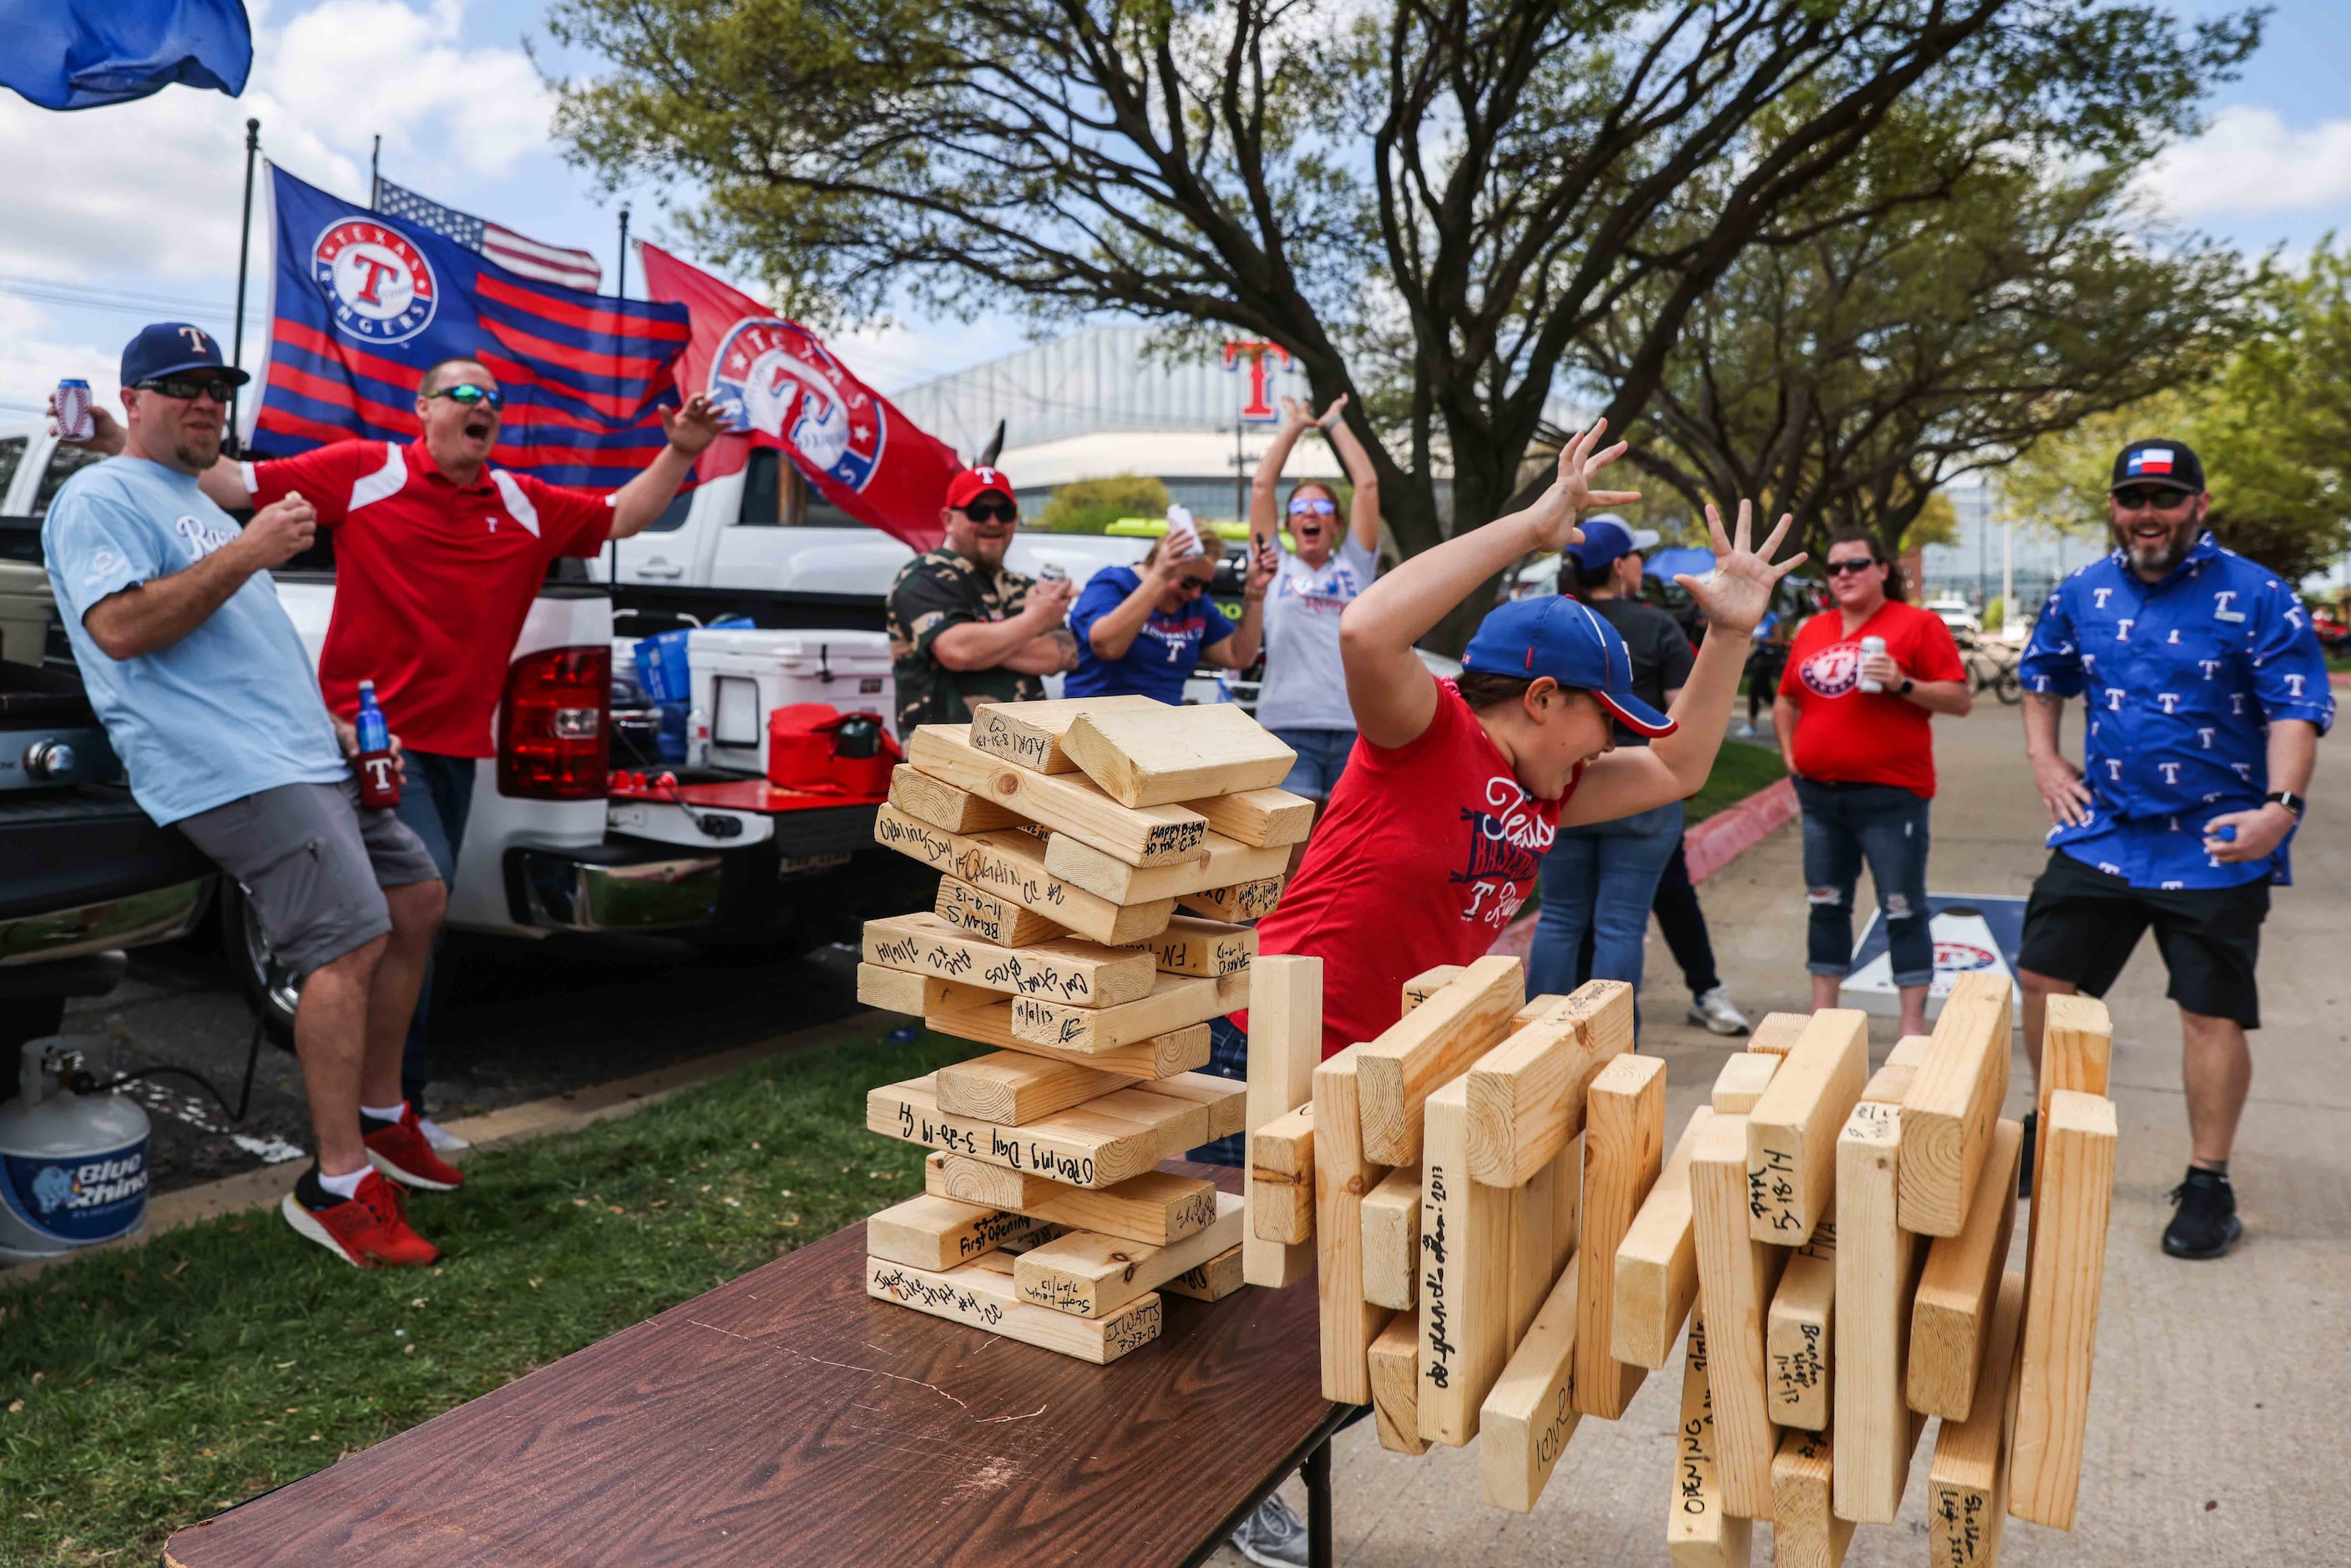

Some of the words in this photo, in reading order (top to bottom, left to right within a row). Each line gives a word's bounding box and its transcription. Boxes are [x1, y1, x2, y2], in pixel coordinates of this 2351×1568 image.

[336, 225, 420, 271] TEXAS
[178, 326, 208, 354] T
[746, 329, 869, 409] TEXAS
[975, 466, 995, 484] T
[1165, 640, 1186, 662] T
[365, 757, 393, 790] T
[947, 905, 962, 923] S
[1463, 881, 1496, 917] T
[78, 1152, 142, 1185] Blue
[67, 1171, 148, 1209] Rhino
[960, 1230, 987, 1257] First
[958, 1292, 981, 1313] #4
[1682, 1418, 1706, 1515] OPENING
